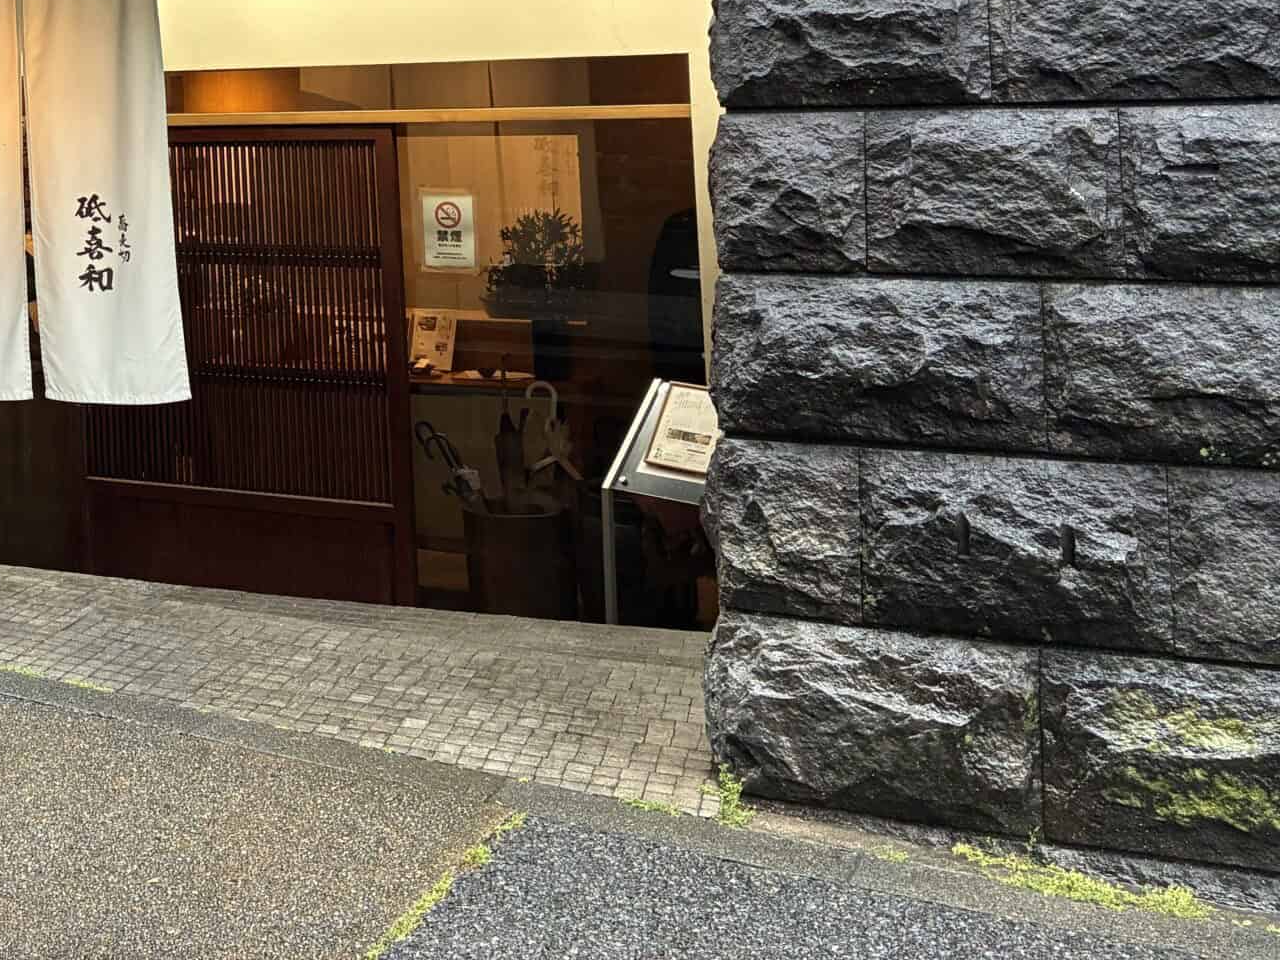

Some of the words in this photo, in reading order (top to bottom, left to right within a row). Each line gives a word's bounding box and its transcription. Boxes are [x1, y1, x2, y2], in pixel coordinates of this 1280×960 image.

[75, 193, 113, 292] 砥喜和
[437, 230, 463, 242] 禁煙
